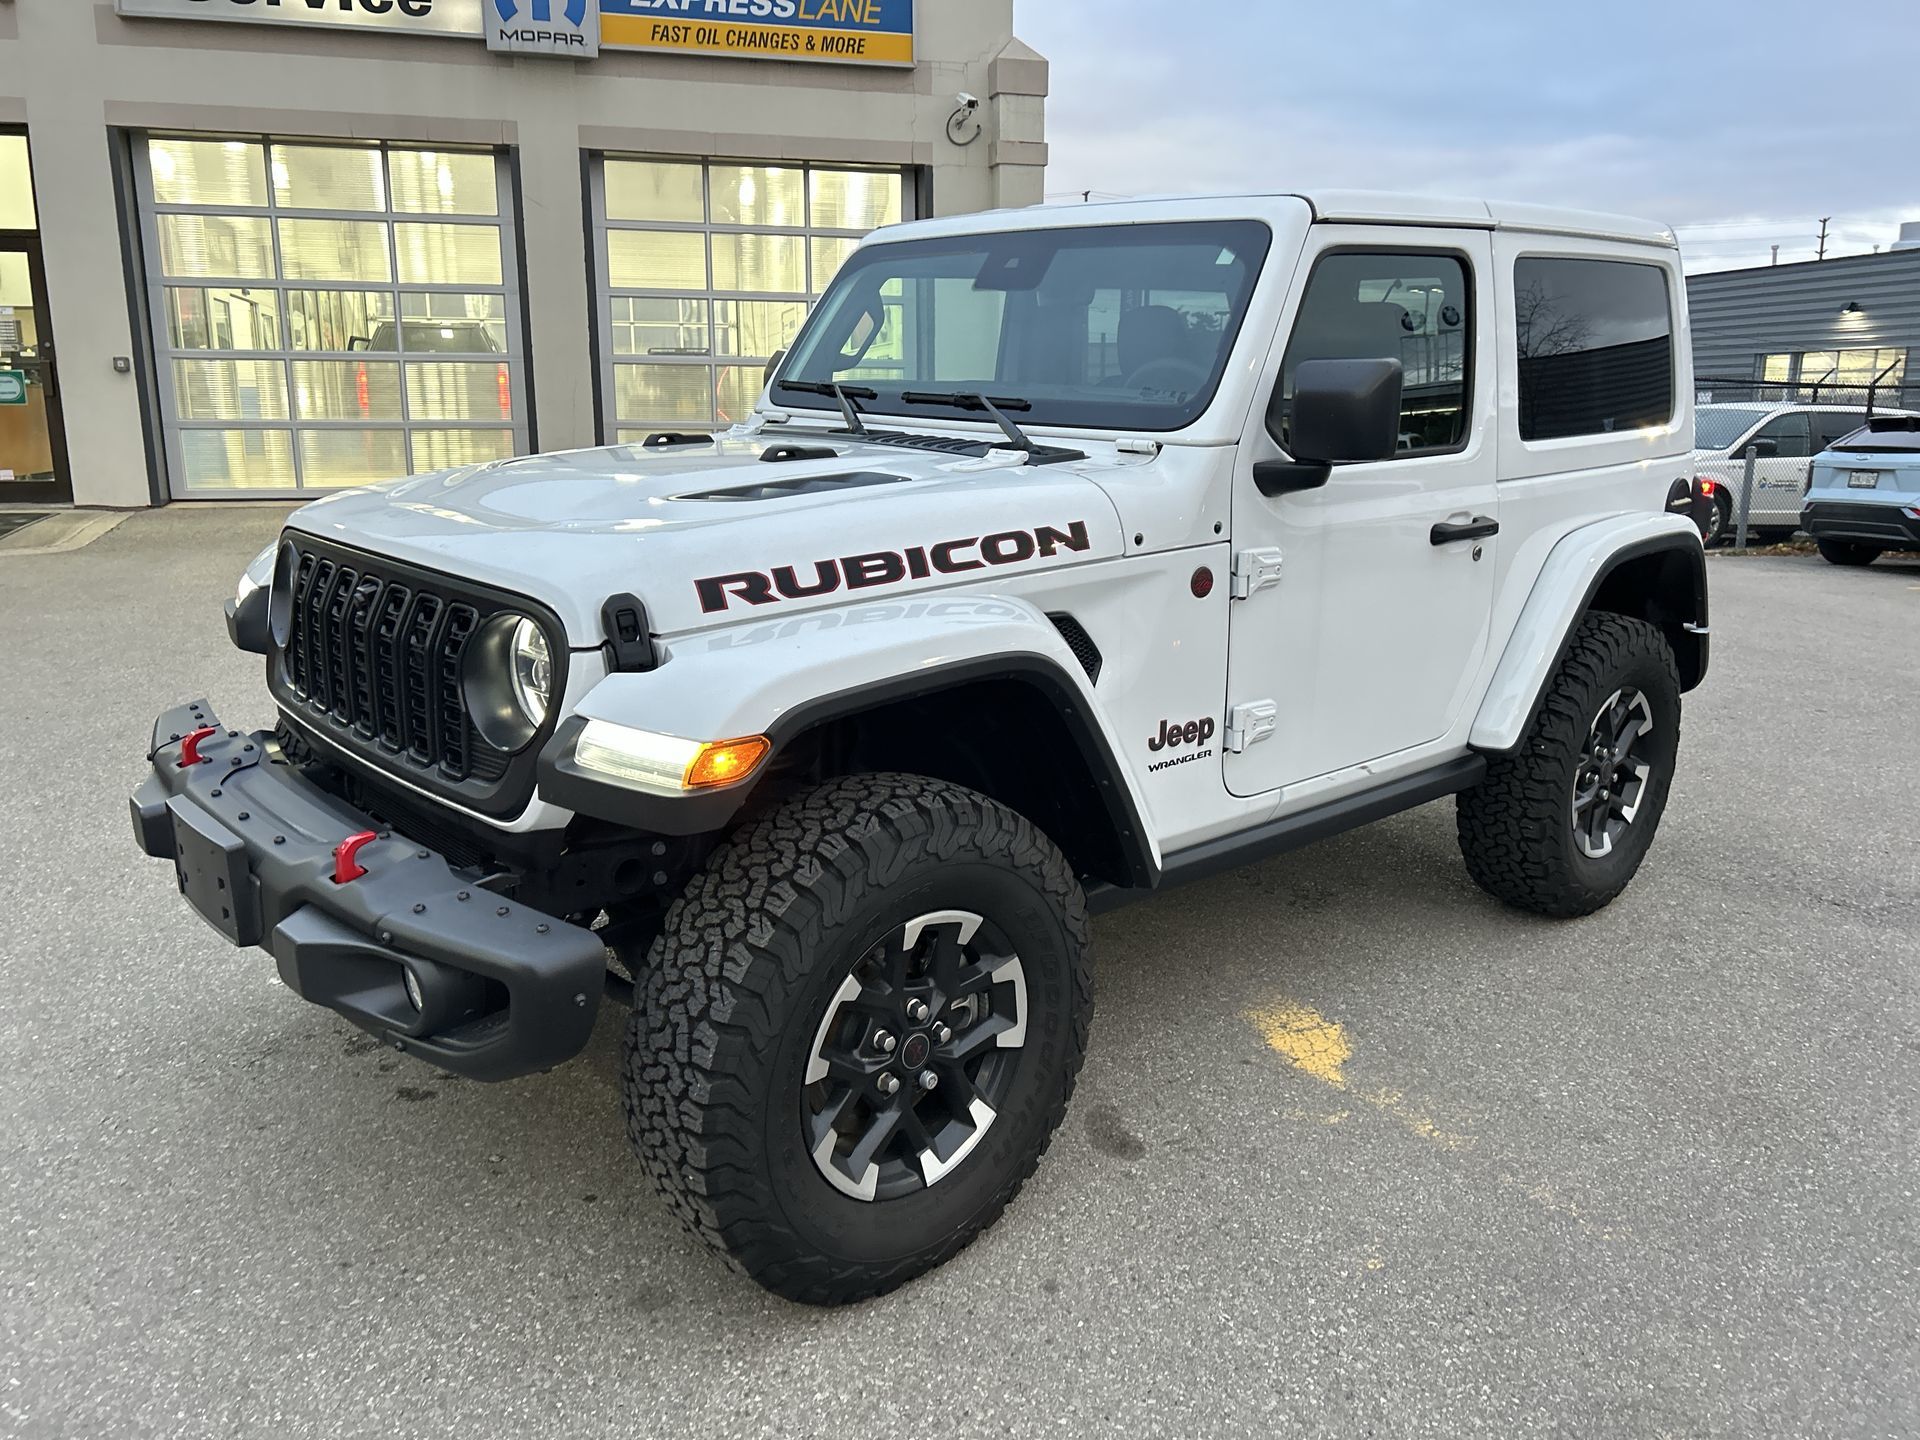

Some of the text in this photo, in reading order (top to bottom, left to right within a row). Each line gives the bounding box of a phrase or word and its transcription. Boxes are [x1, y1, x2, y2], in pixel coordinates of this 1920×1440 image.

[499, 29, 585, 46] MOPAR
[651, 24, 866, 54] FAST OIL CHANGES & MORE
[693, 520, 1091, 614] RUBICON
[1148, 717, 1215, 752] Jeep
[1147, 749, 1212, 773] WRANGLER
